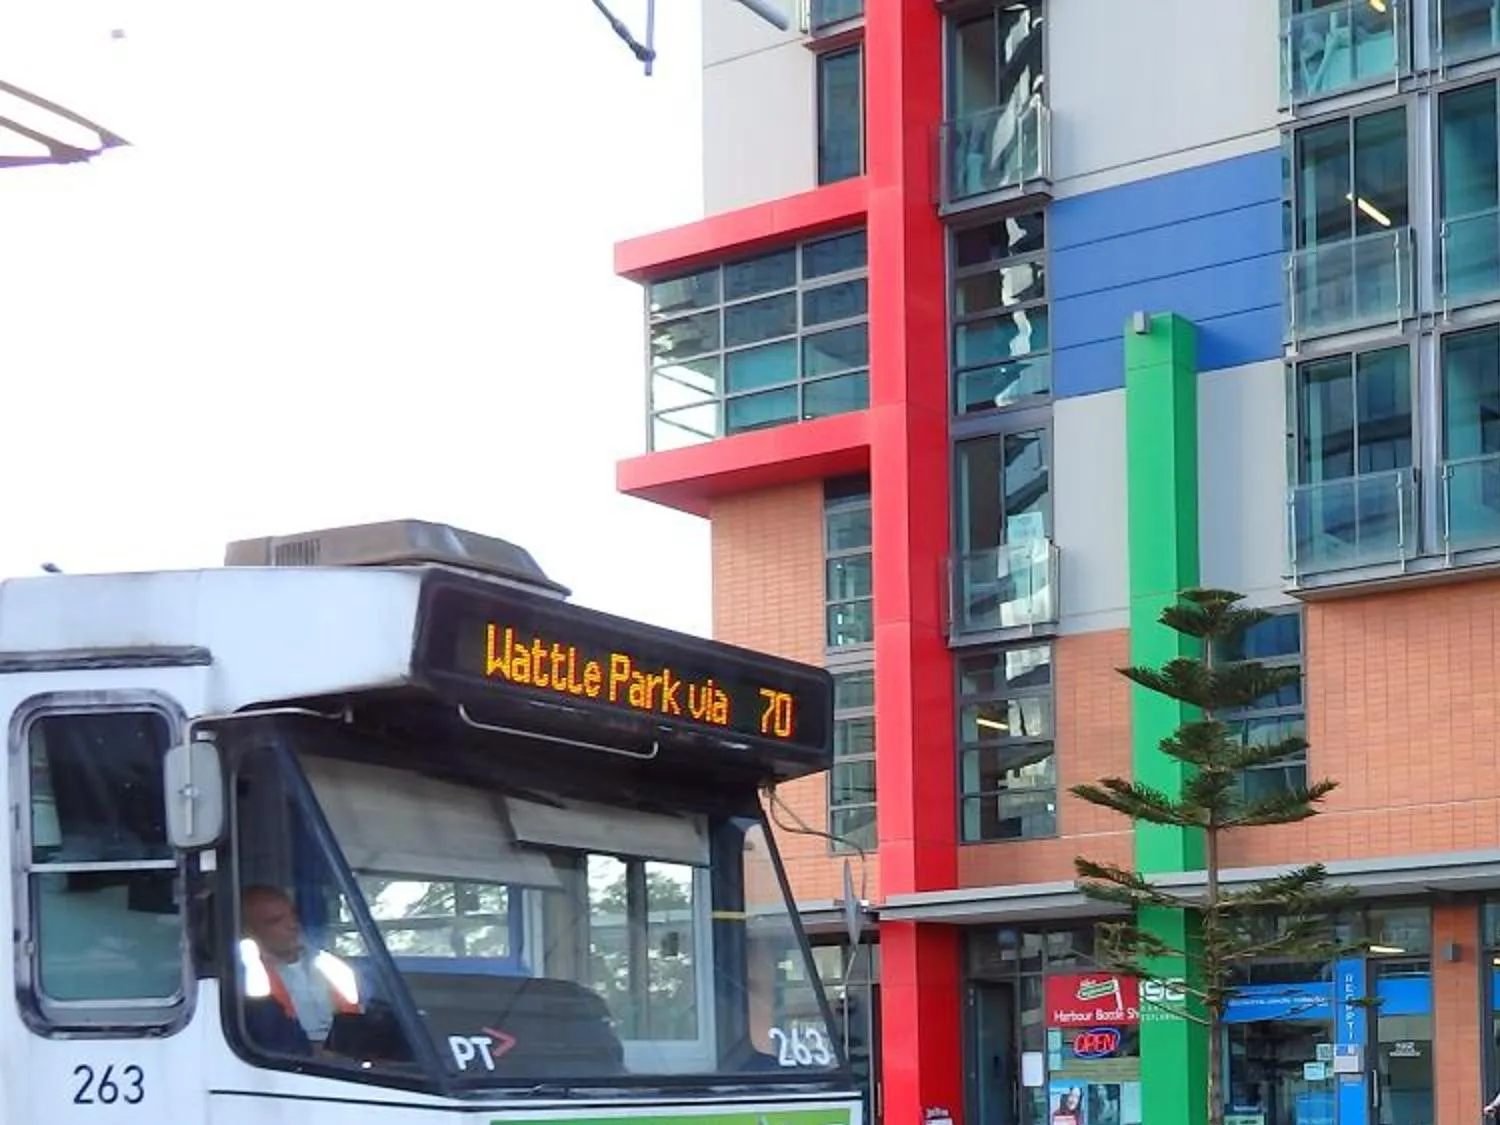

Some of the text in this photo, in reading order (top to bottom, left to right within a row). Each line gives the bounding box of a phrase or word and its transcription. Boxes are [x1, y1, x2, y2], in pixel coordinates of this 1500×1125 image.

[486, 623, 794, 738] Wattle Park via 70
[768, 1027, 831, 1067] 263
[1074, 1033, 1115, 1052] OPEN
[73, 1064, 145, 1105] 263
